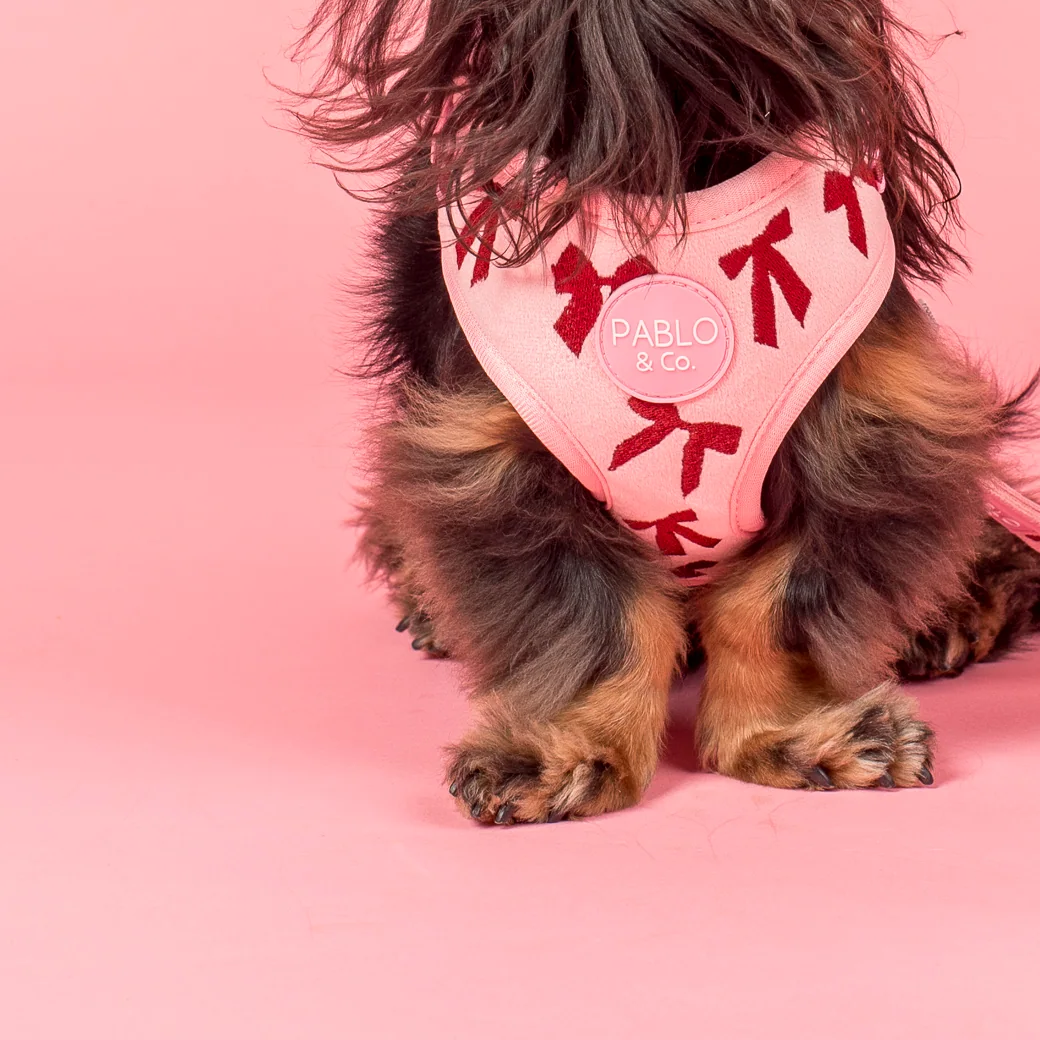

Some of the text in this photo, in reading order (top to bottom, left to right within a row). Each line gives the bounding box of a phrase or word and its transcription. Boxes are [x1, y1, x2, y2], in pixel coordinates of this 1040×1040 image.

[611, 317, 718, 347] PABLO
[636, 351, 696, 372] & Co.
